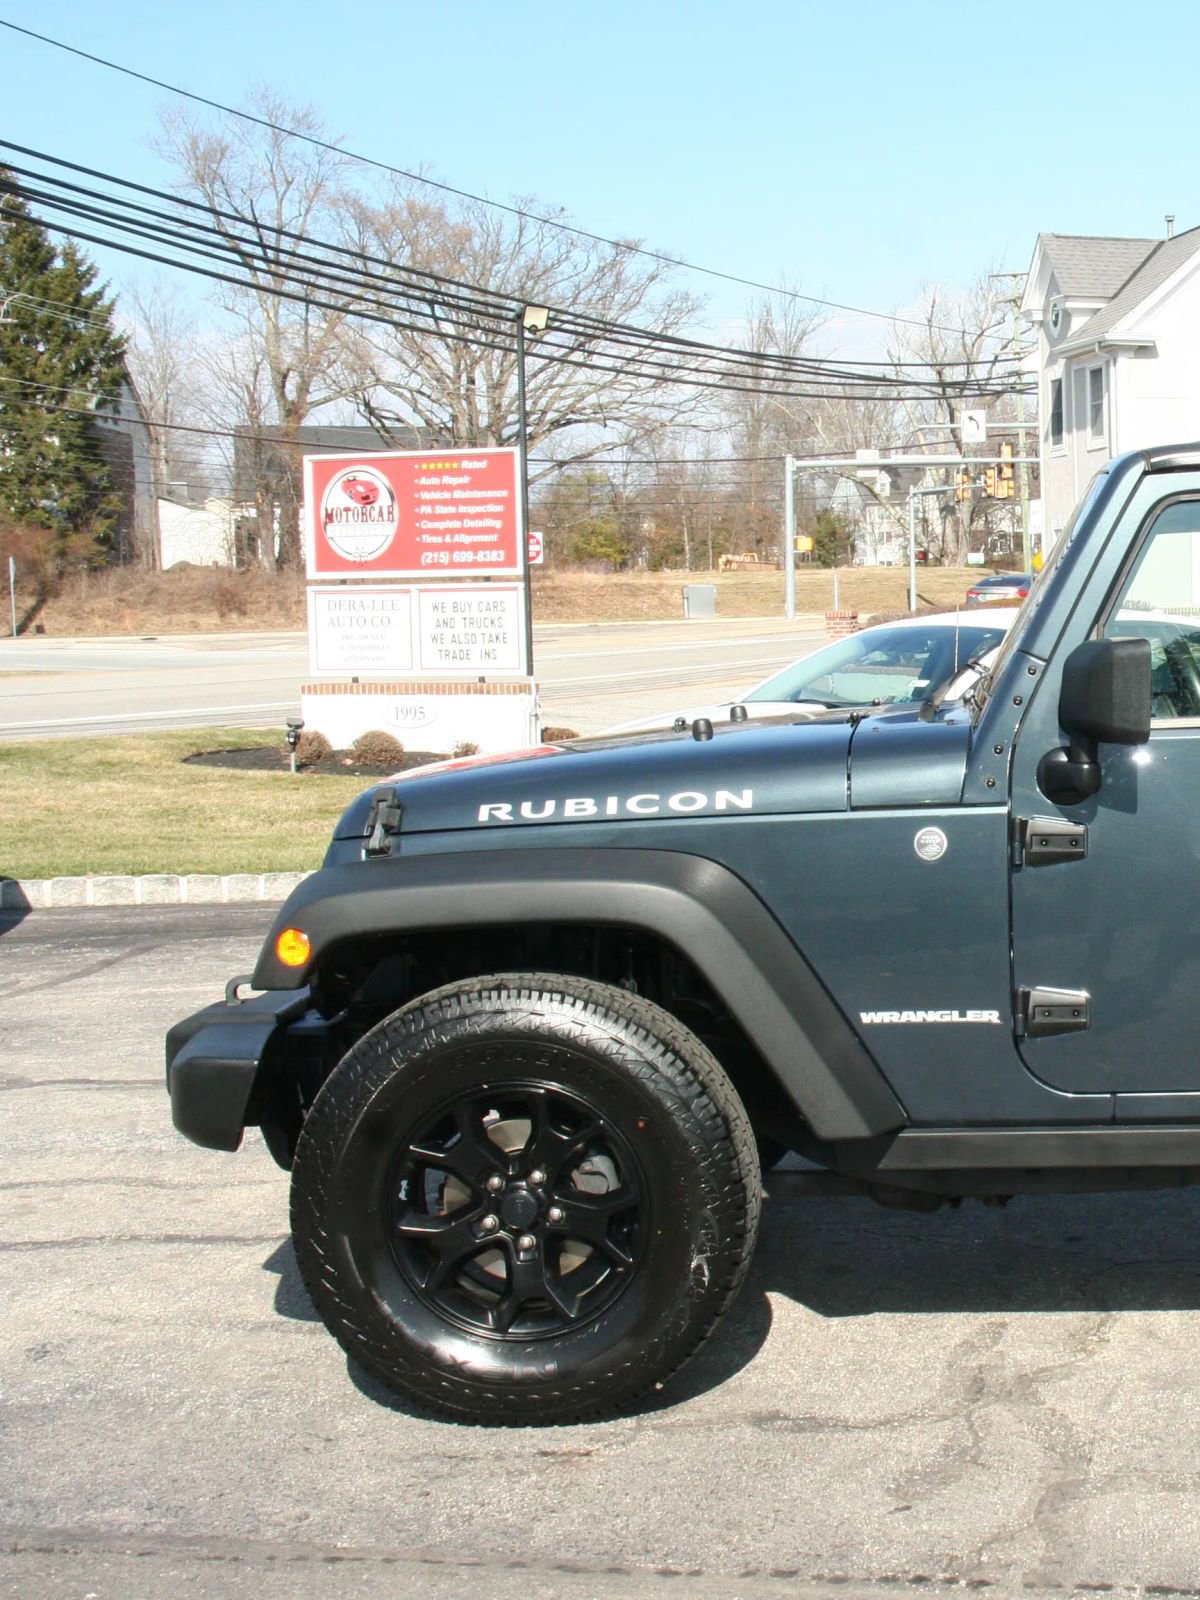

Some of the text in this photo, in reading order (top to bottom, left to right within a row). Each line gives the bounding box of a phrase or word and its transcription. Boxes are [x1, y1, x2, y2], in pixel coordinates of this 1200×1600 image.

[461, 460, 488, 469] Rated
[419, 475, 471, 486] Auto Repair
[420, 490, 508, 499] Vehicle Maintenance
[324, 505, 395, 524] MOTORCAR
[420, 504, 504, 514] PA State Inspection
[420, 518, 502, 530] Complete Detailing
[422, 533, 498, 544] Tires & Alignment
[421, 551, 449, 566] (215)
[327, 599, 400, 611] DERA-LEE
[432, 600, 506, 613] WE BUY CARS
[328, 615, 367, 628] AUTO
[435, 616, 504, 629] AND TRUCKS
[431, 632, 508, 645] WE ALSO TAKE
[438, 648, 497, 661] TRADE INS
[394, 706, 426, 721] 1995
[478, 789, 753, 822] RUBICON
[860, 1010, 1003, 1024] WRANGLER
